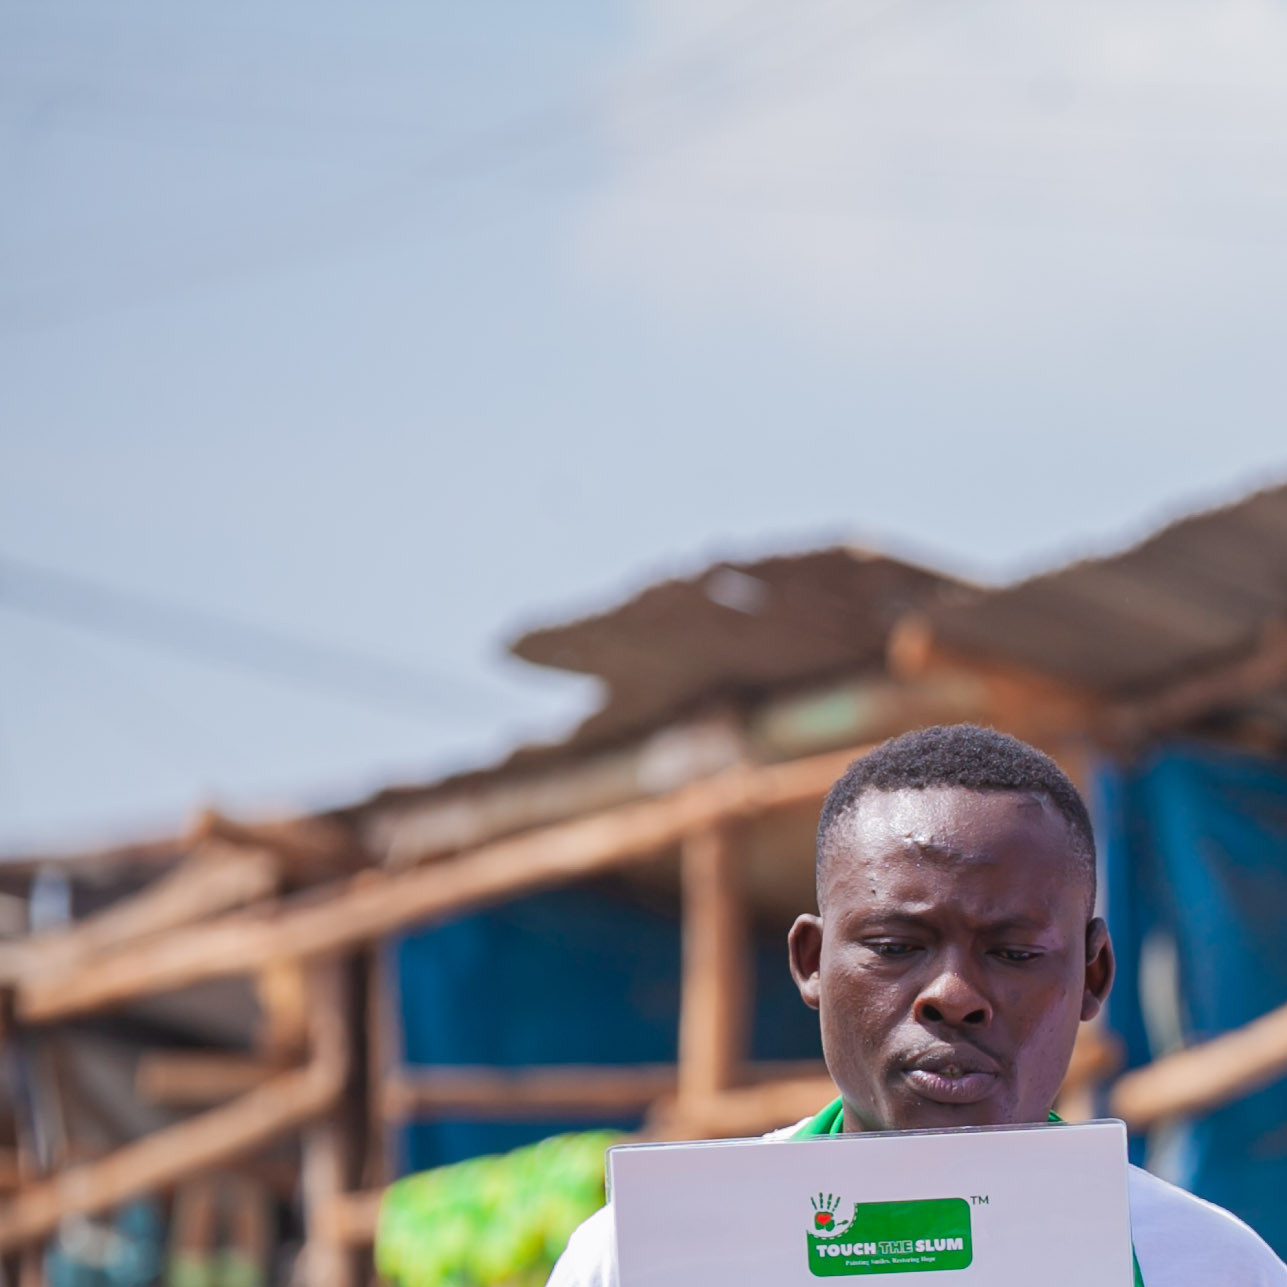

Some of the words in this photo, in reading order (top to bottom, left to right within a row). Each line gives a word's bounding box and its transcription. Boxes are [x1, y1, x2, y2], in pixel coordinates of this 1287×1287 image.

[816, 1242, 876, 1257] TOUCH
[878, 1240, 913, 1255] THE
[915, 1237, 963, 1253] SLUM
